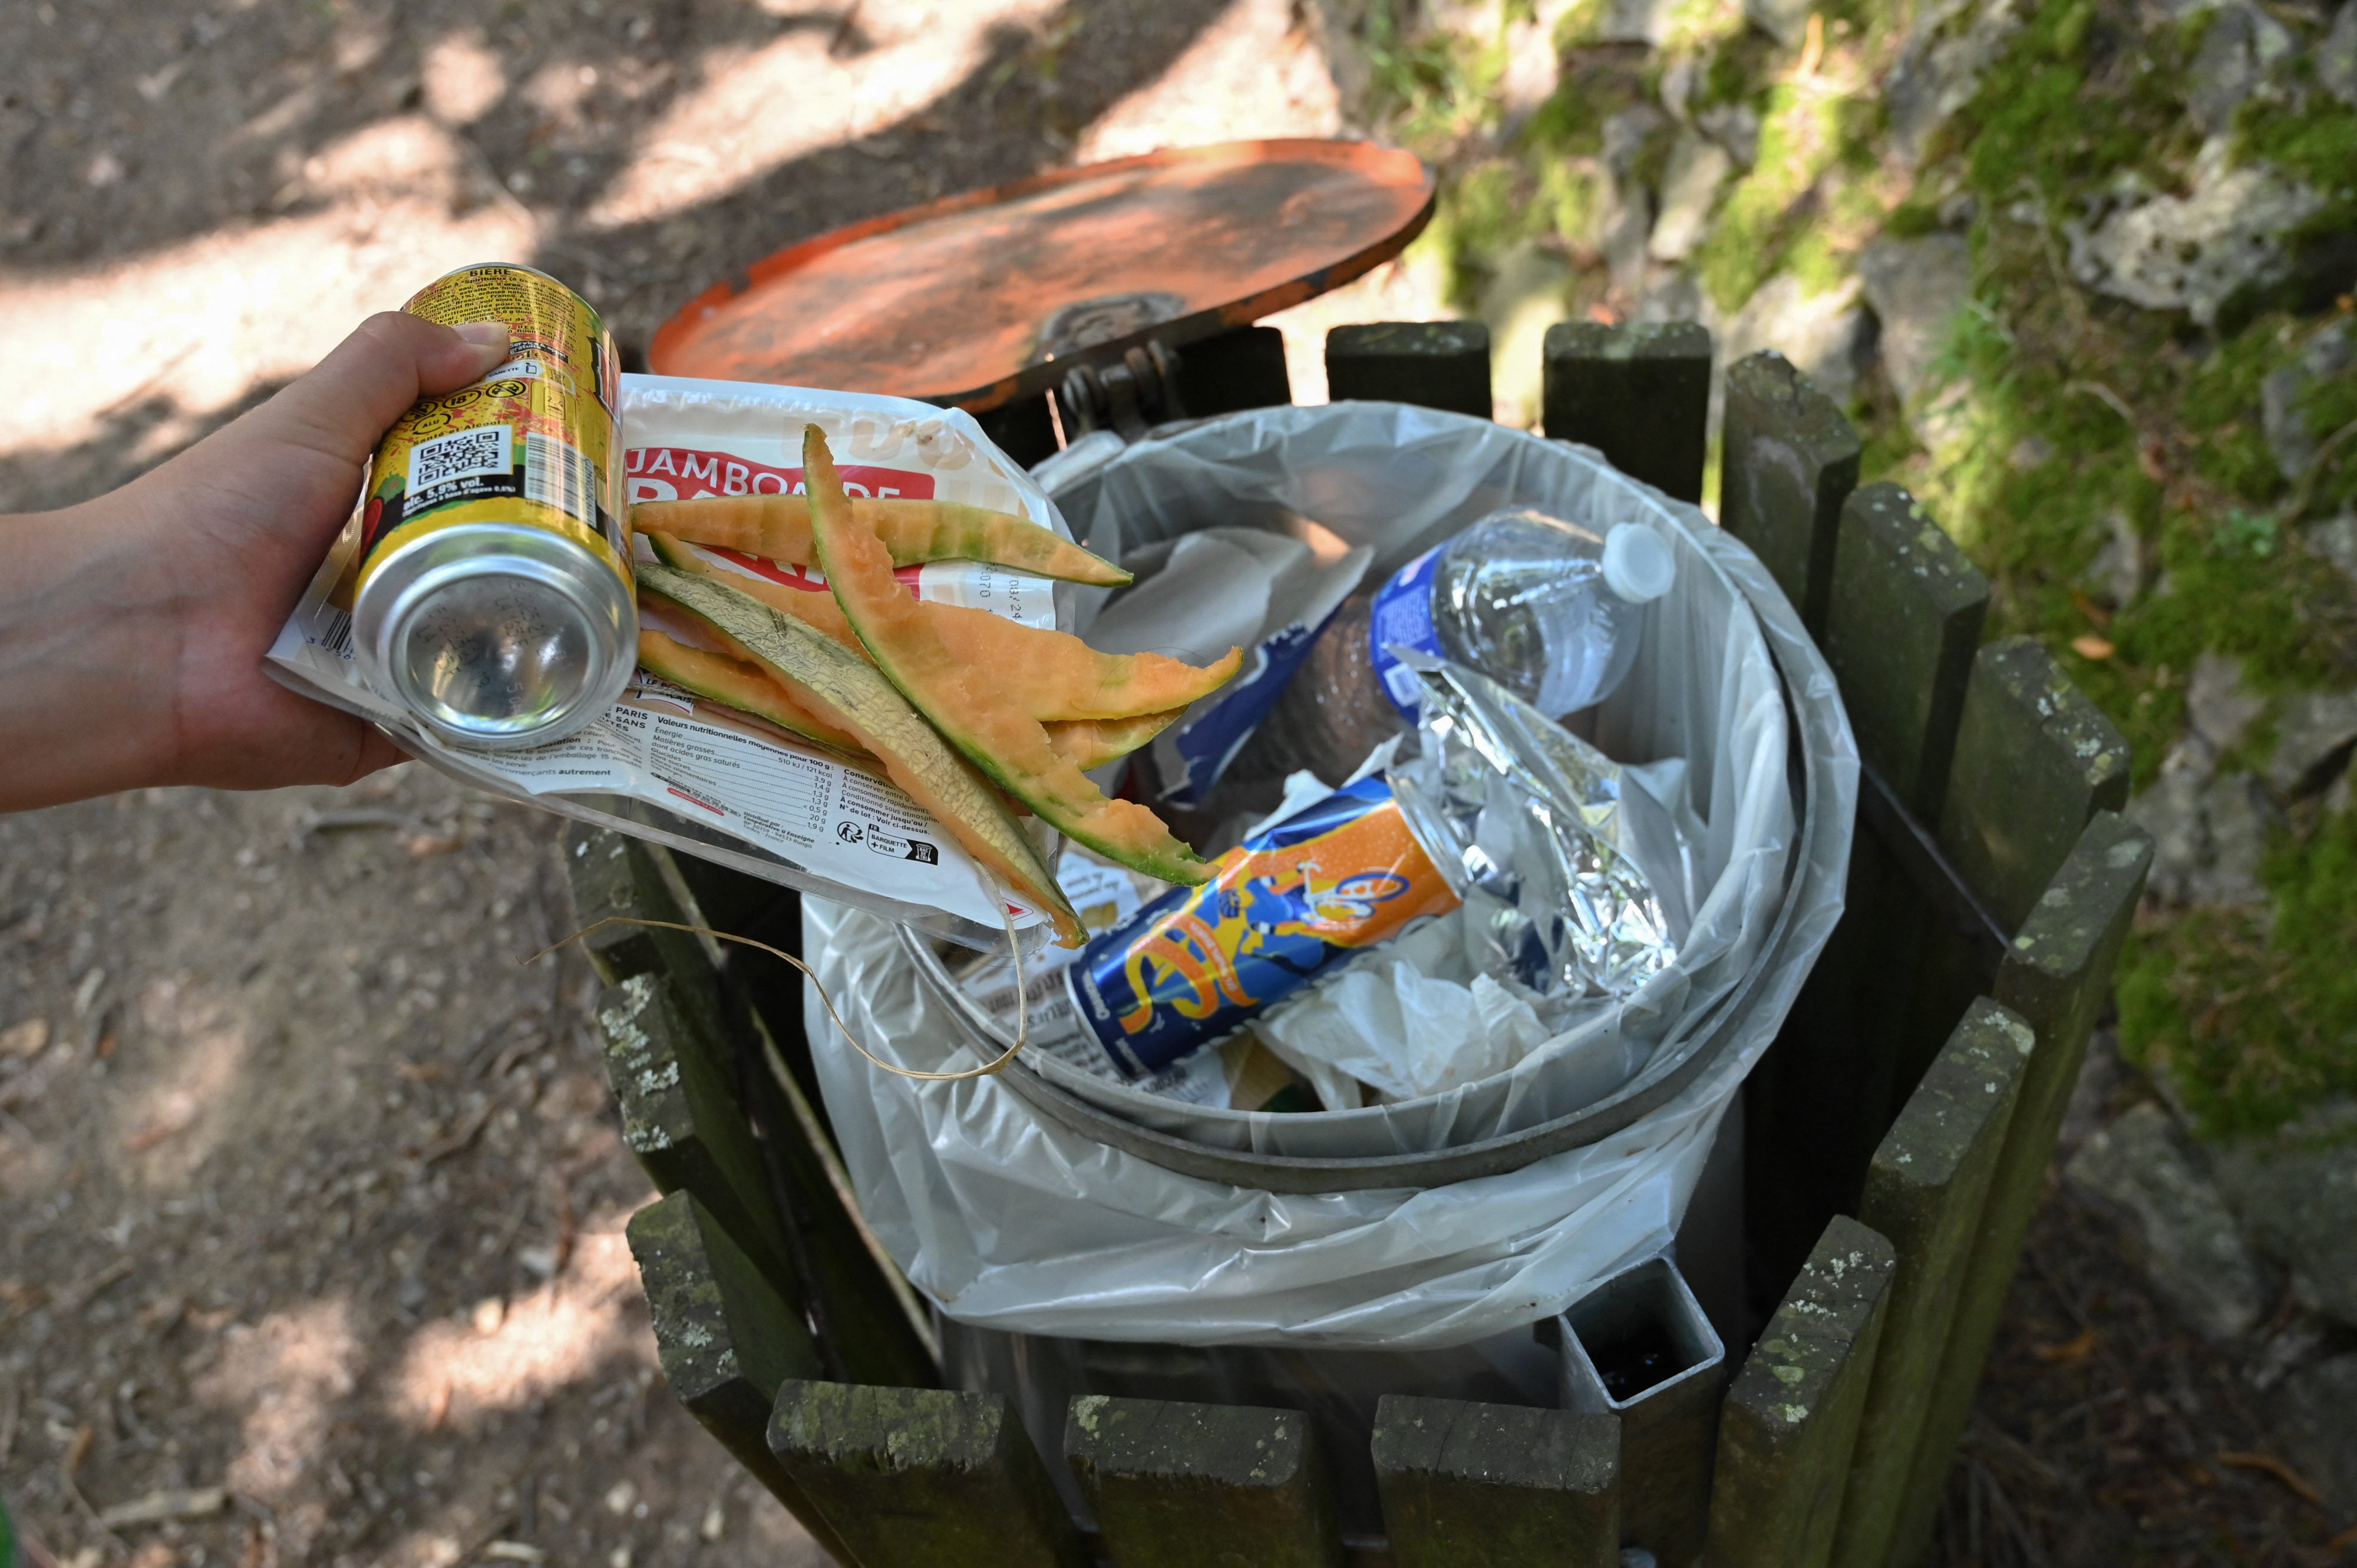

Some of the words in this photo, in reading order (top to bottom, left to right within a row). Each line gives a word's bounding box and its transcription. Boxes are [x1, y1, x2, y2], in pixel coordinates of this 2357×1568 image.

[470, 268, 512, 277] BIÈRE
[488, 367, 519, 378] CANETTE
[413, 431, 443, 445] Santé
[464, 420, 501, 430] Alcool
[422, 419, 440, 428] ALU
[460, 477, 484, 488] vol.
[616, 707, 648, 720] PARIS
[616, 717, 646, 729] SANS
[658, 716, 688, 729] Valeurs
[689, 725, 747, 744] nutritionnelles
[748, 741, 788, 757] moyennes
[790, 754, 807, 763] pour
[809, 759, 823, 767] 100
[651, 748, 682, 762] Glucides
[651, 752, 667, 762] dont
[668, 759, 691, 771] sucres
[652, 741, 668, 750] dont
[669, 747, 694, 758] acides
[695, 754, 712, 763] gras
[713, 758, 741, 769] saturés
[653, 735, 685, 748] Matières
[686, 744, 715, 755] grasses
[814, 775, 826, 784] 3,9
[655, 727, 683, 739] Énergie
[806, 765, 817, 774] 121
[818, 769, 833, 778] kcal
[673, 767, 717, 786] alimentaires
[809, 805, 821, 813] 0,5
[850, 779, 884, 794] conserver
[885, 790, 903, 800] entre
[841, 790, 883, 808] Conditionné
[884, 806, 900, 814] sous
[849, 786, 886, 803] consommer
[887, 798, 926, 814] rapidement
[744, 811, 770, 824] Distribué
[847, 800, 890, 817] consommer
[890, 813, 923, 827] jusqu'au
[861, 810, 871, 818] lot
[876, 816, 891, 826] Voir
[892, 821, 930, 835] ci-dessus.
[744, 816, 780, 832] Coopérative
[787, 831, 815, 843] Enseigne
[765, 833, 784, 843] France
[871, 834, 907, 849] BARQUETTE
[879, 844, 895, 853] FILM
